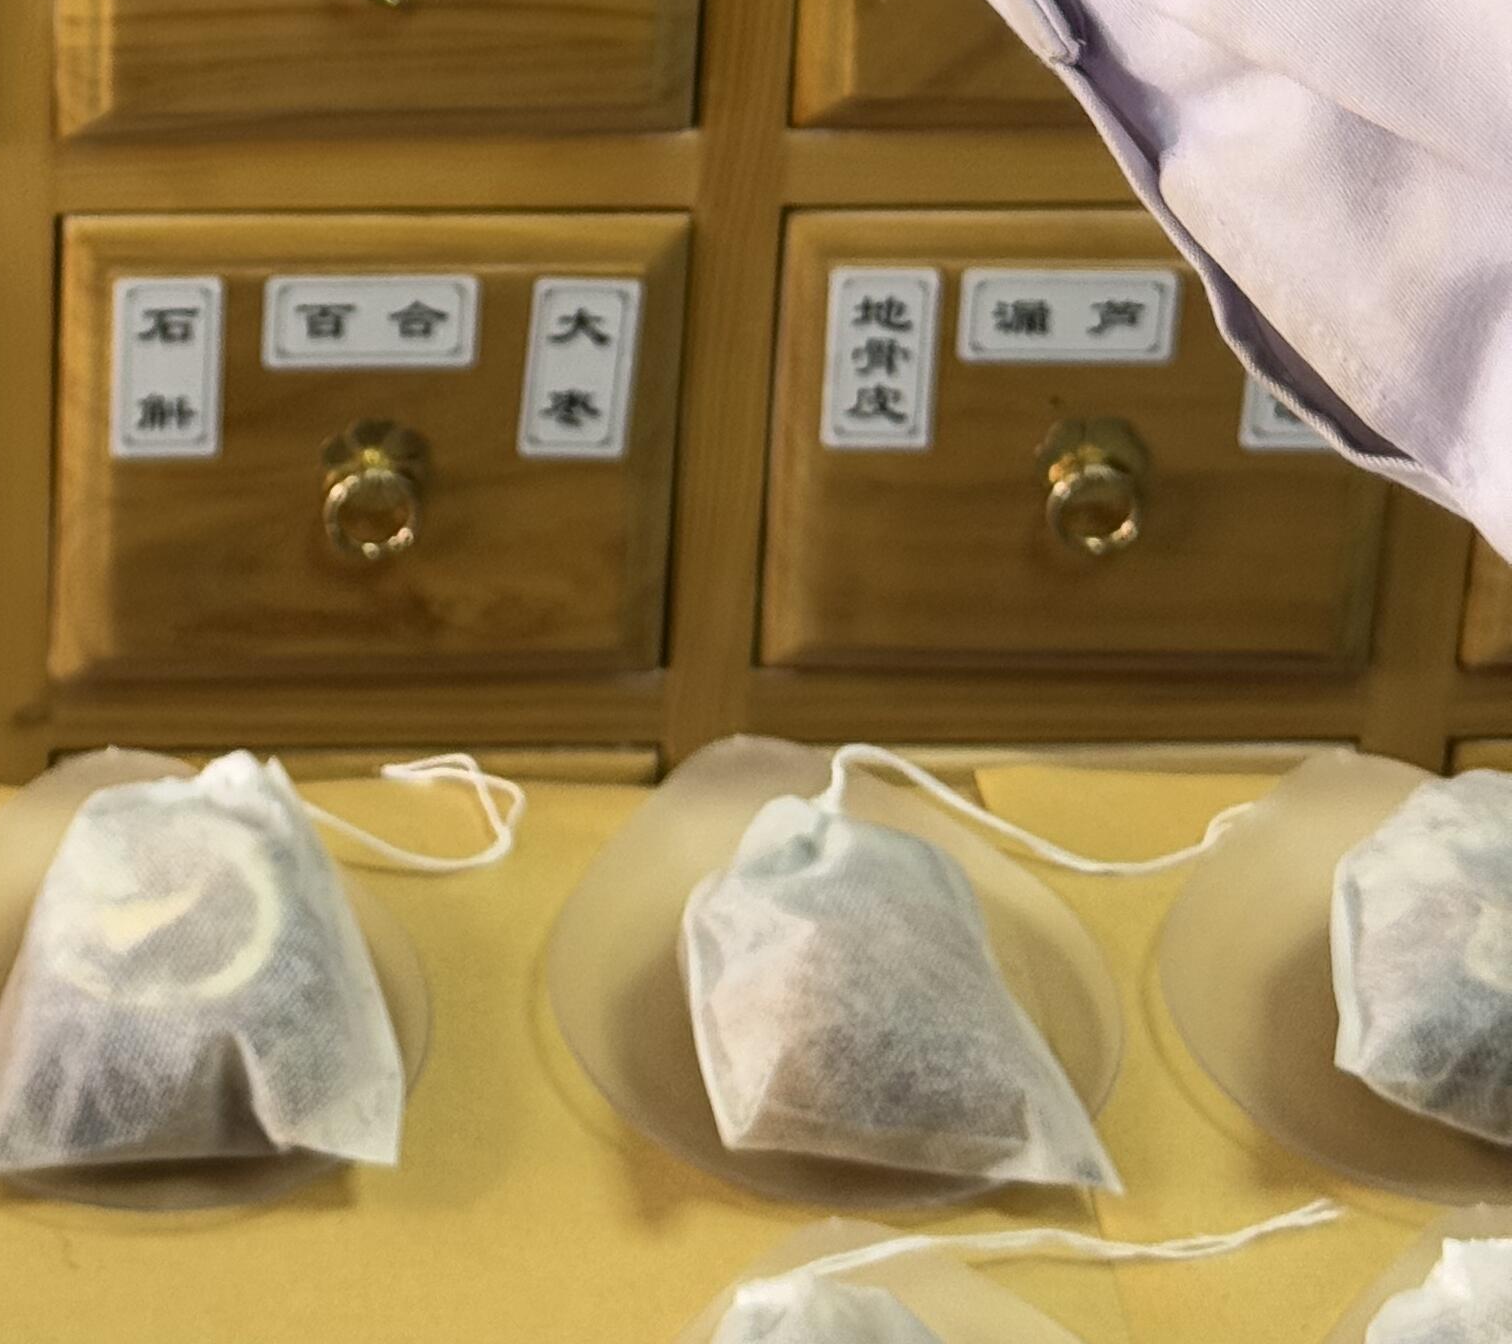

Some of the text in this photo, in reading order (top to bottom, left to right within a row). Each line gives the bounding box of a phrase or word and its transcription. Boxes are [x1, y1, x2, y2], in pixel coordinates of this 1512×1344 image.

[294, 299, 451, 342] 百合
[845, 294, 915, 426] 地骨皮
